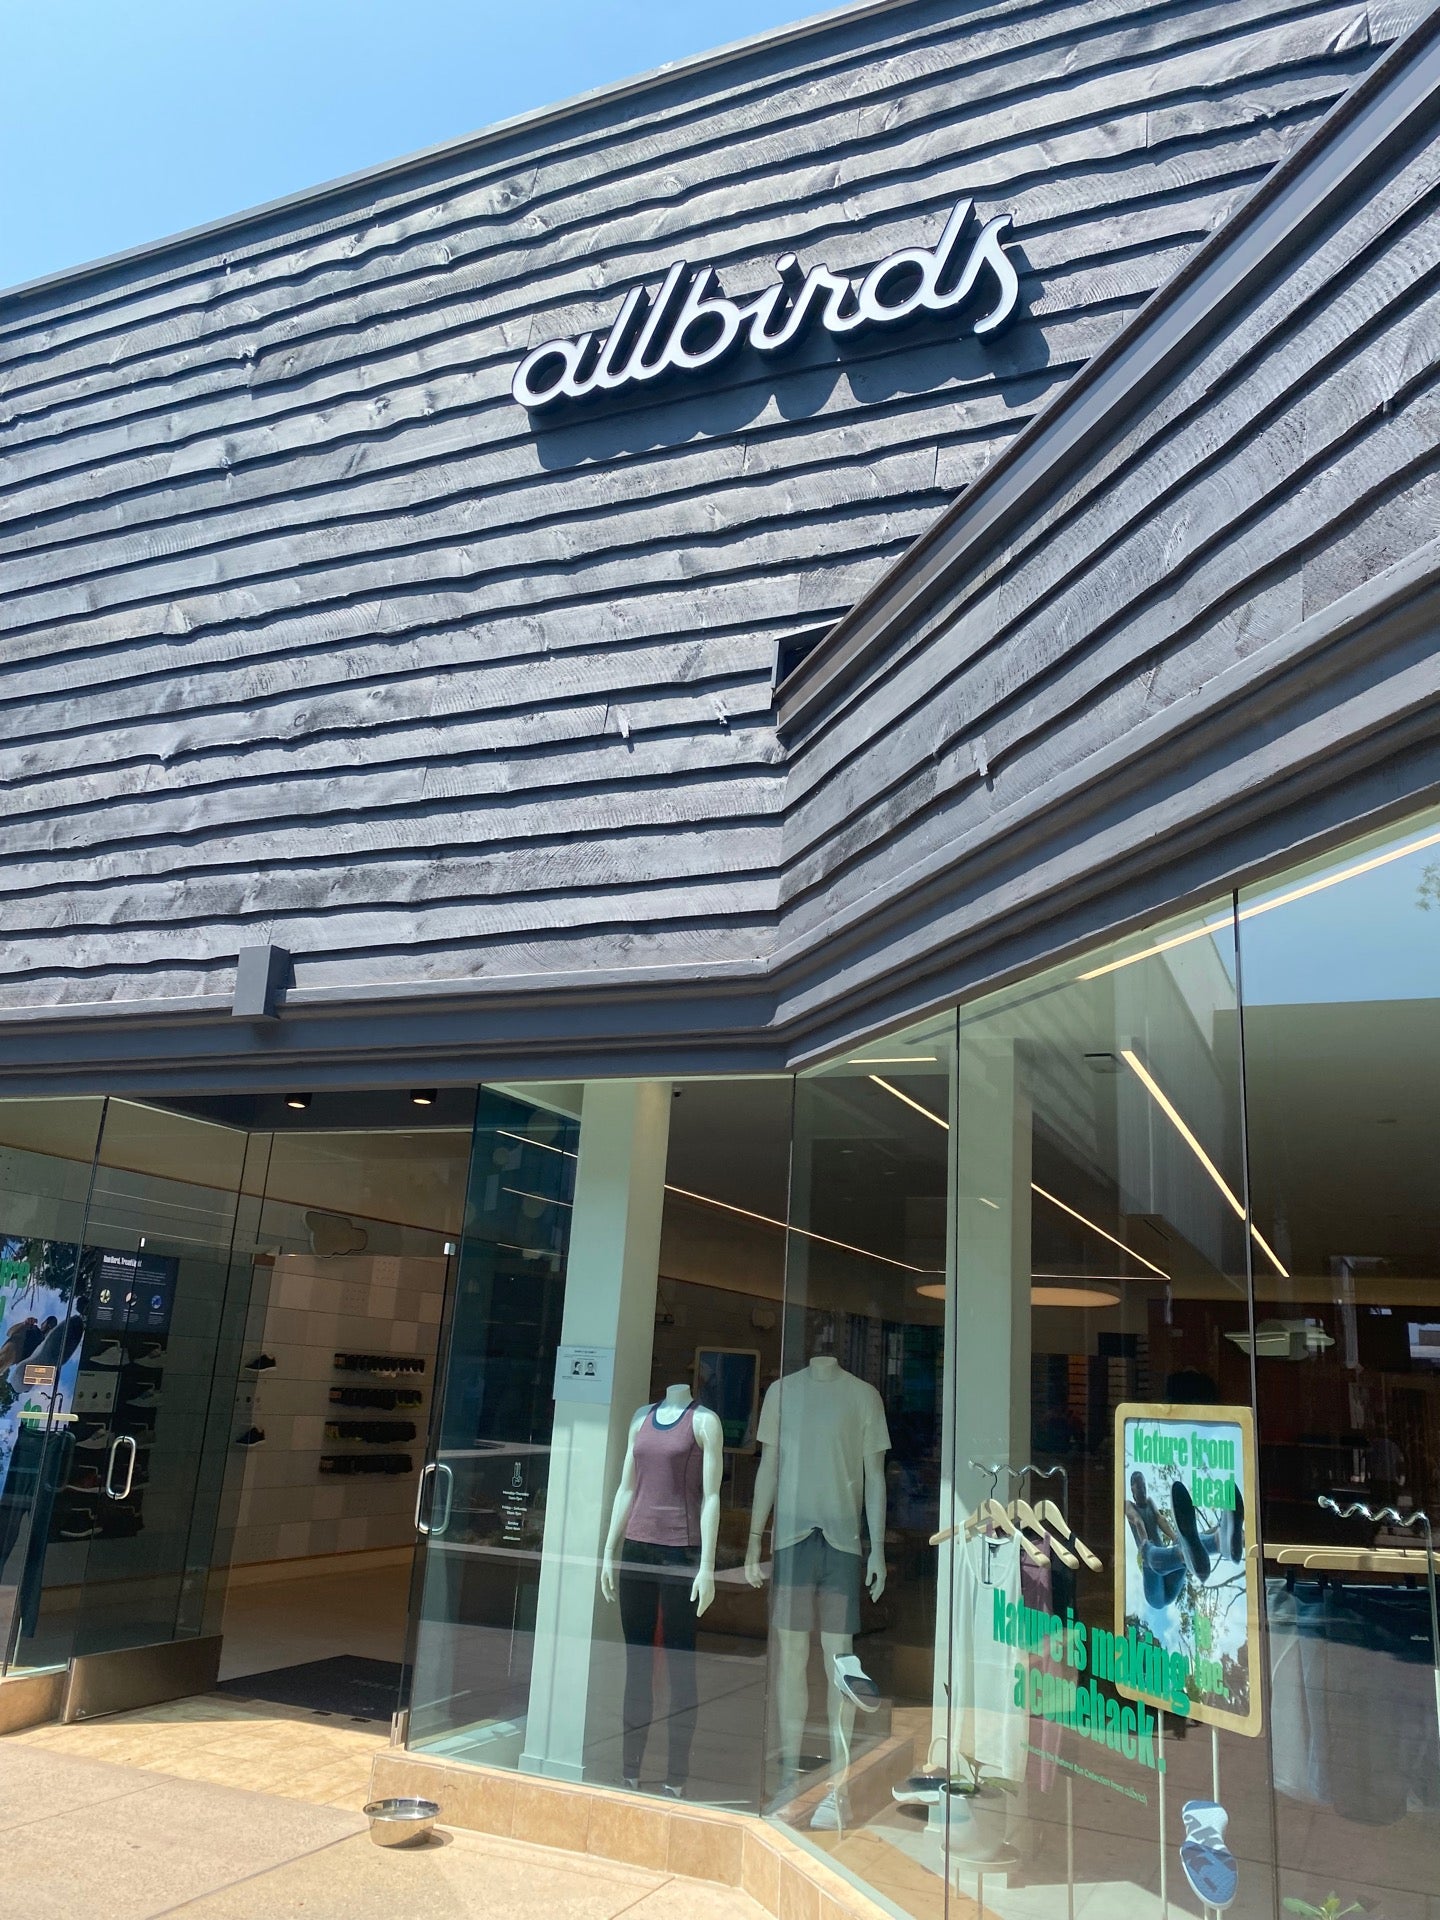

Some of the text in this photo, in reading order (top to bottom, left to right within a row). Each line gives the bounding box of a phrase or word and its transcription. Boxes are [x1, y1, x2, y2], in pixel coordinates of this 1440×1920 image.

[511, 197, 1019, 408] allbirds
[1133, 1428, 1235, 1470] Nature from
[1192, 1469, 1236, 1511] head
[993, 1587, 1191, 1717] Nature is making
[1194, 1608, 1212, 1651] to
[1014, 1662, 1167, 1774] a comeback.
